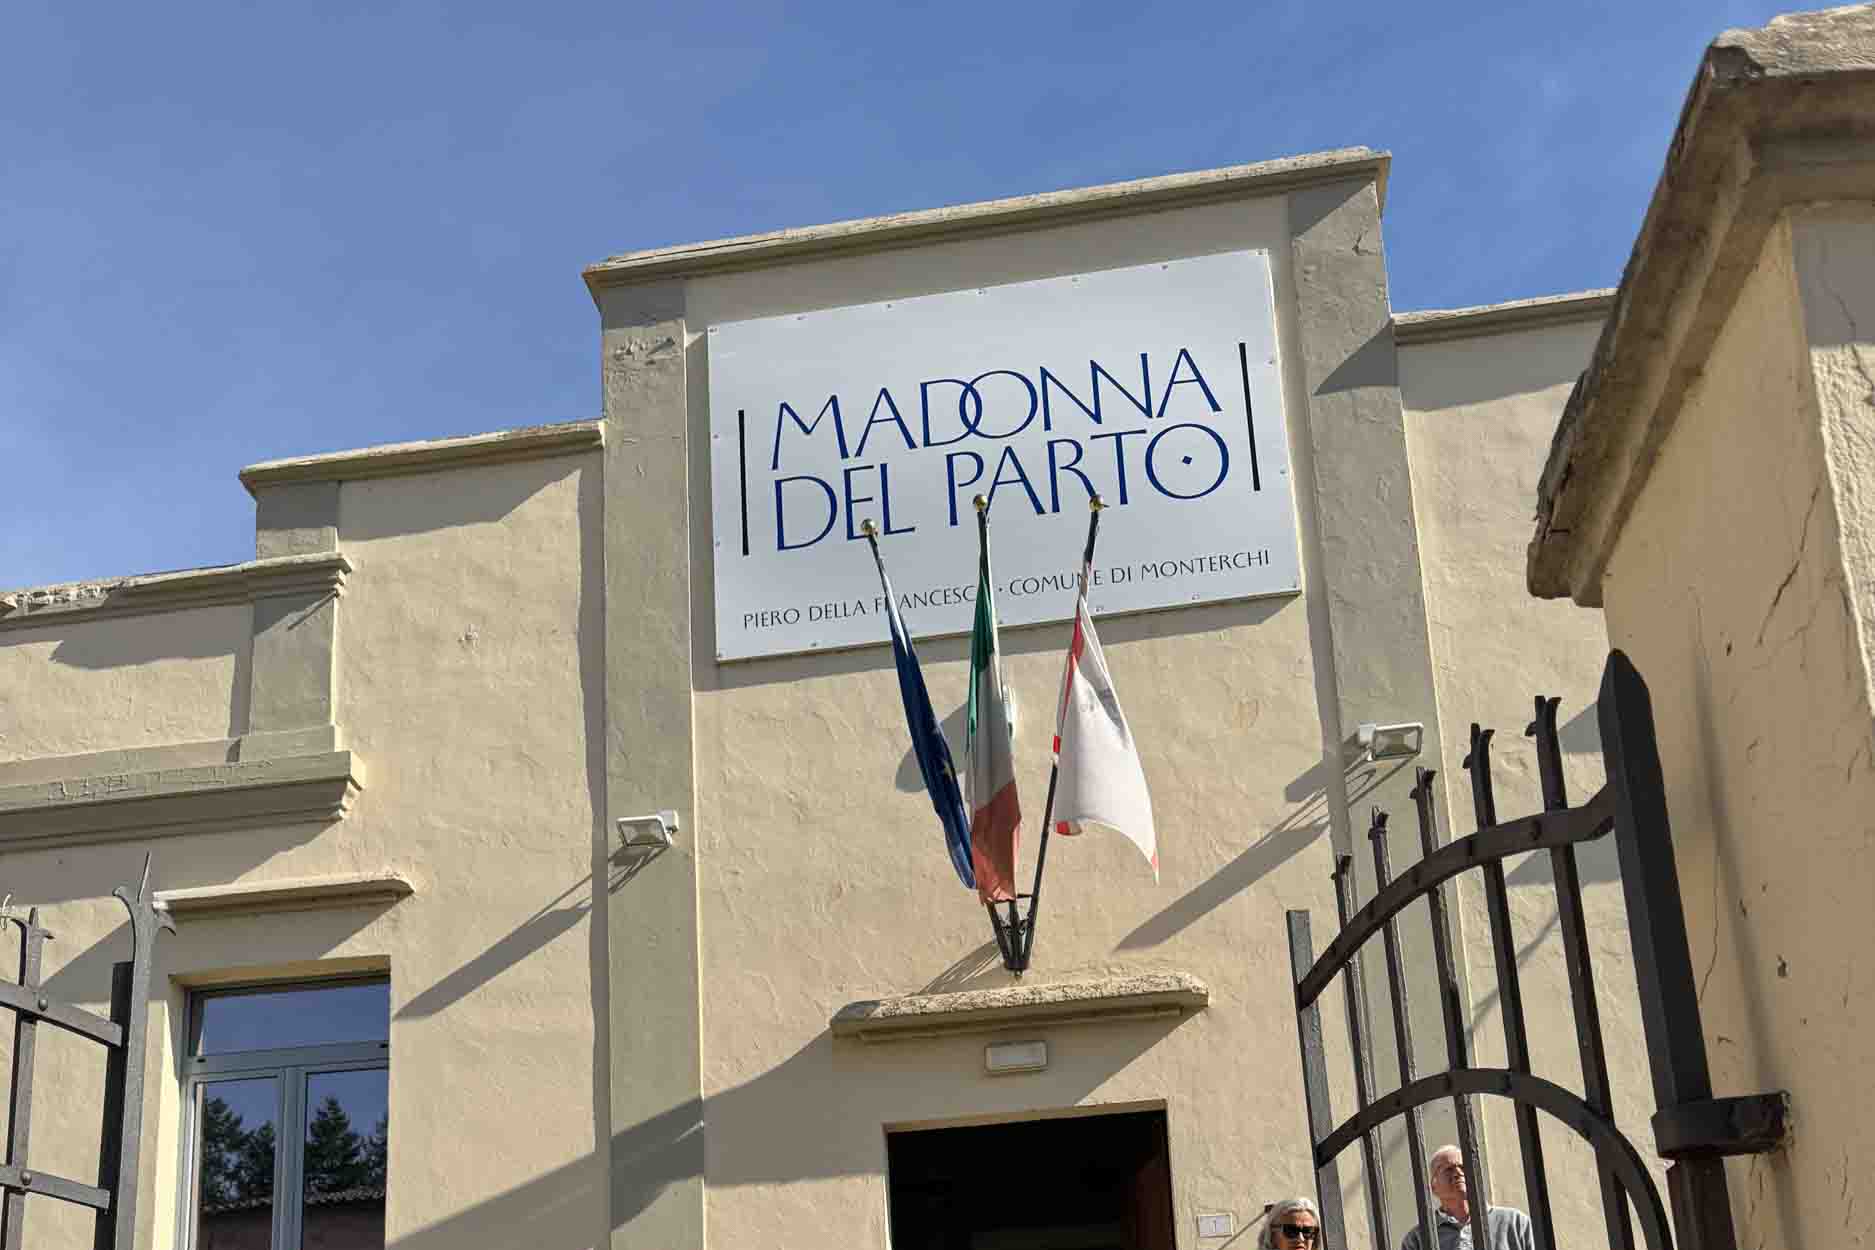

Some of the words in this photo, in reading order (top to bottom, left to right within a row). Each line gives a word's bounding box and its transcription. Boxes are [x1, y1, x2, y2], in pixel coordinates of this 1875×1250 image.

[771, 347, 1221, 470] MADONNA
[774, 463, 916, 552] DEL
[945, 423, 1229, 527] PARTO
[743, 608, 801, 630] PIERO
[809, 600, 867, 622] DELLA
[874, 585, 982, 614] FANCESC
[1111, 566, 1132, 584] DI
[1141, 549, 1271, 580] MONTERCHI
